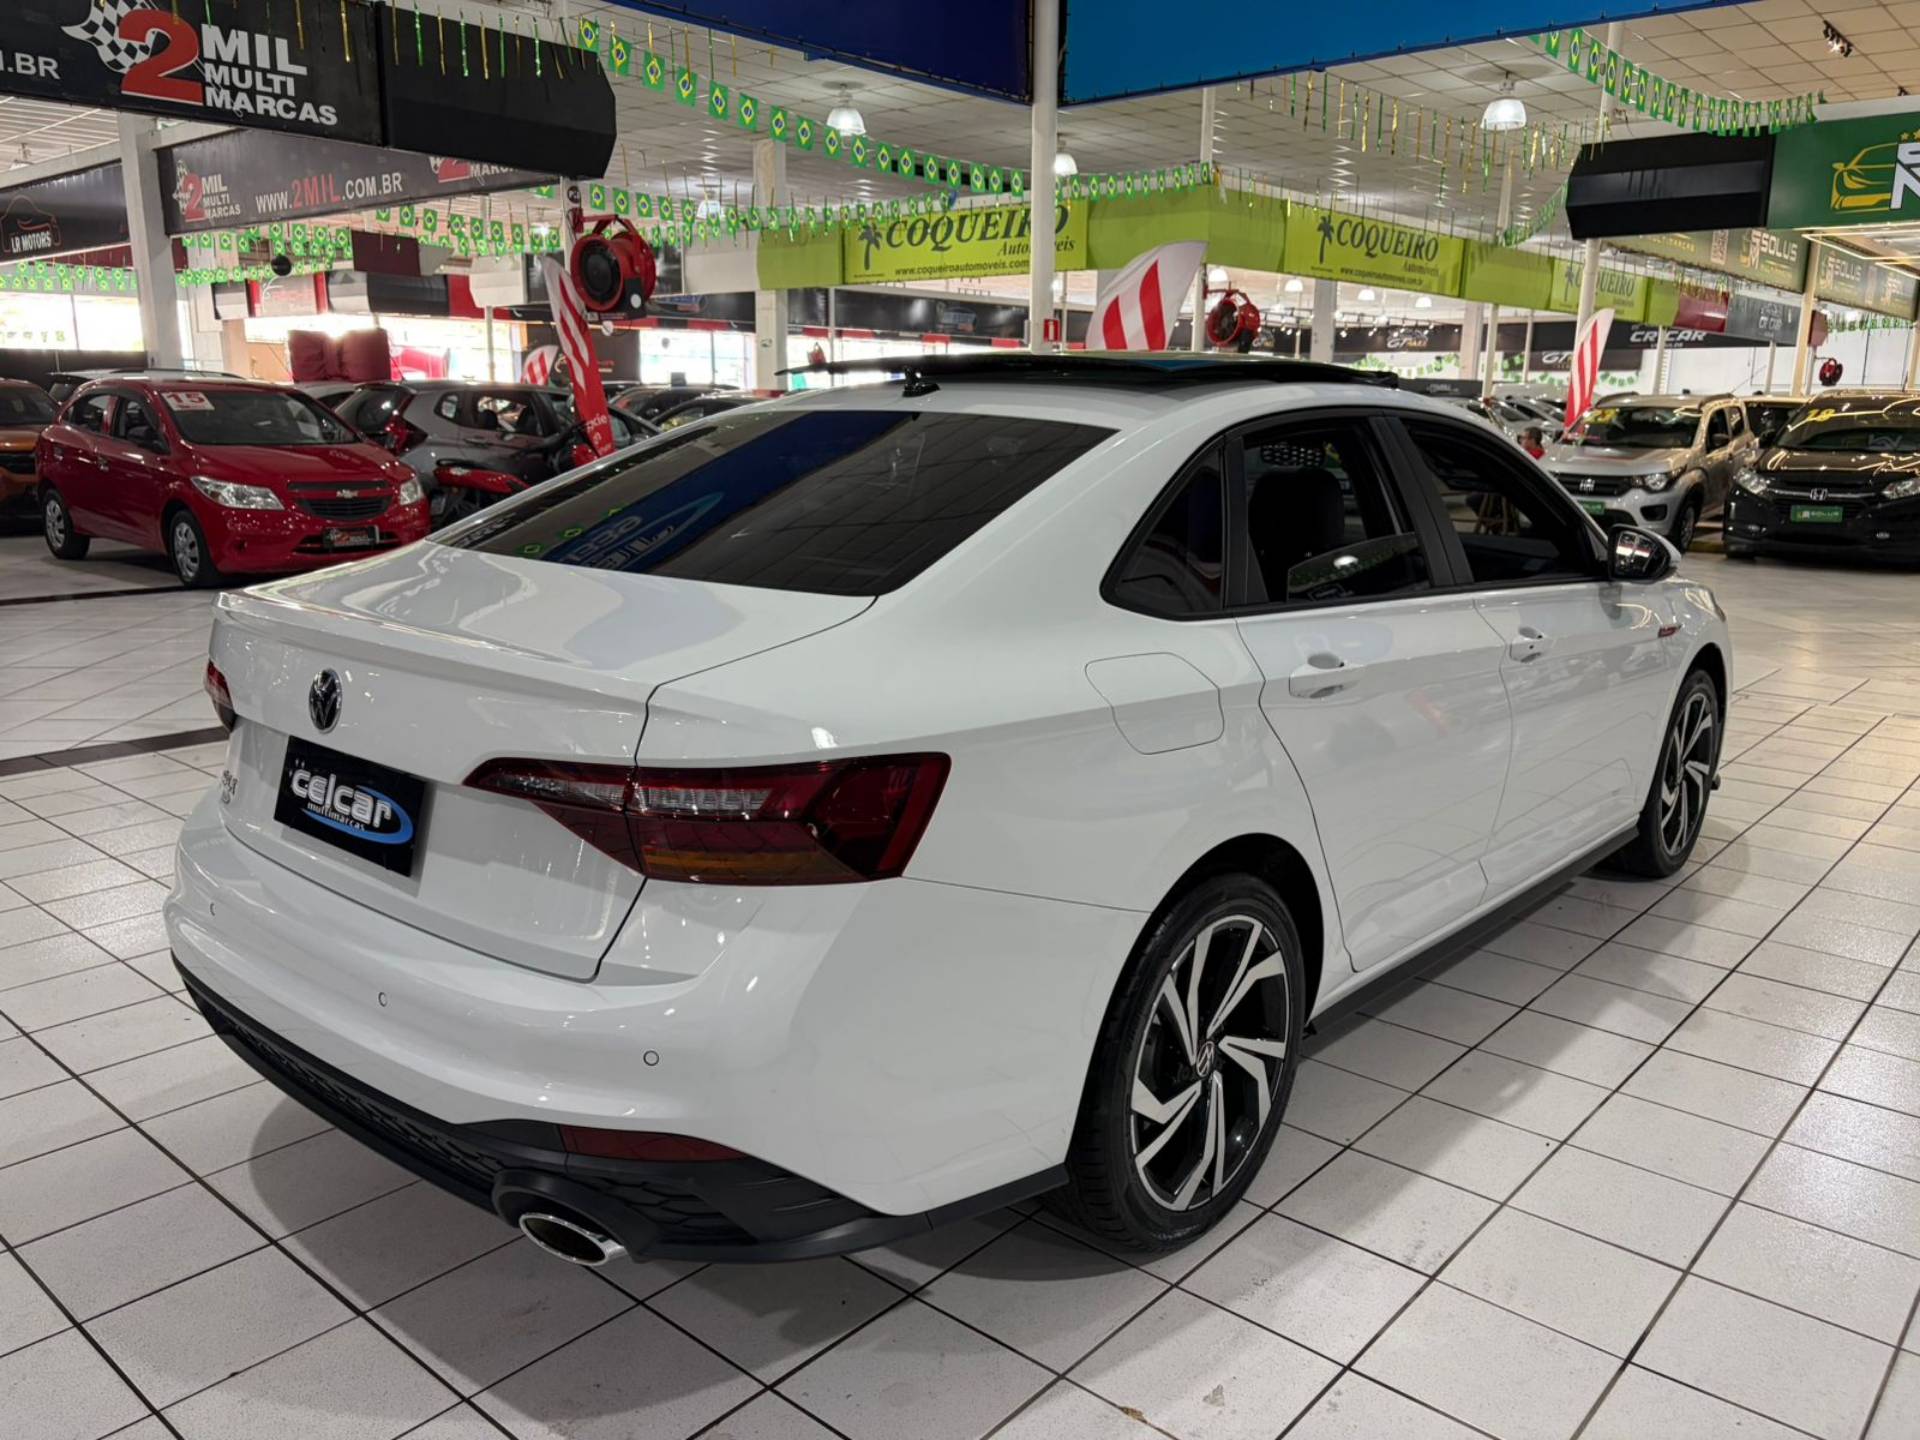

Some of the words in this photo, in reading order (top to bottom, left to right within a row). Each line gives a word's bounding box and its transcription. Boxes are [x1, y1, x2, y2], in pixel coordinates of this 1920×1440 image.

[201, 23, 308, 76] MIL
[204, 62, 296, 97] MULTI
[204, 86, 339, 126] MARCAS
[201, 173, 228, 195] MIL
[255, 171, 403, 215] WWW.2MIL.COM.BR
[21, 230, 52, 251] MOTORS
[1336, 218, 1439, 262] COQUEIRO
[1761, 232, 1798, 262] SOLUS
[291, 768, 392, 829] celcar
[307, 801, 366, 833] multimarcas
